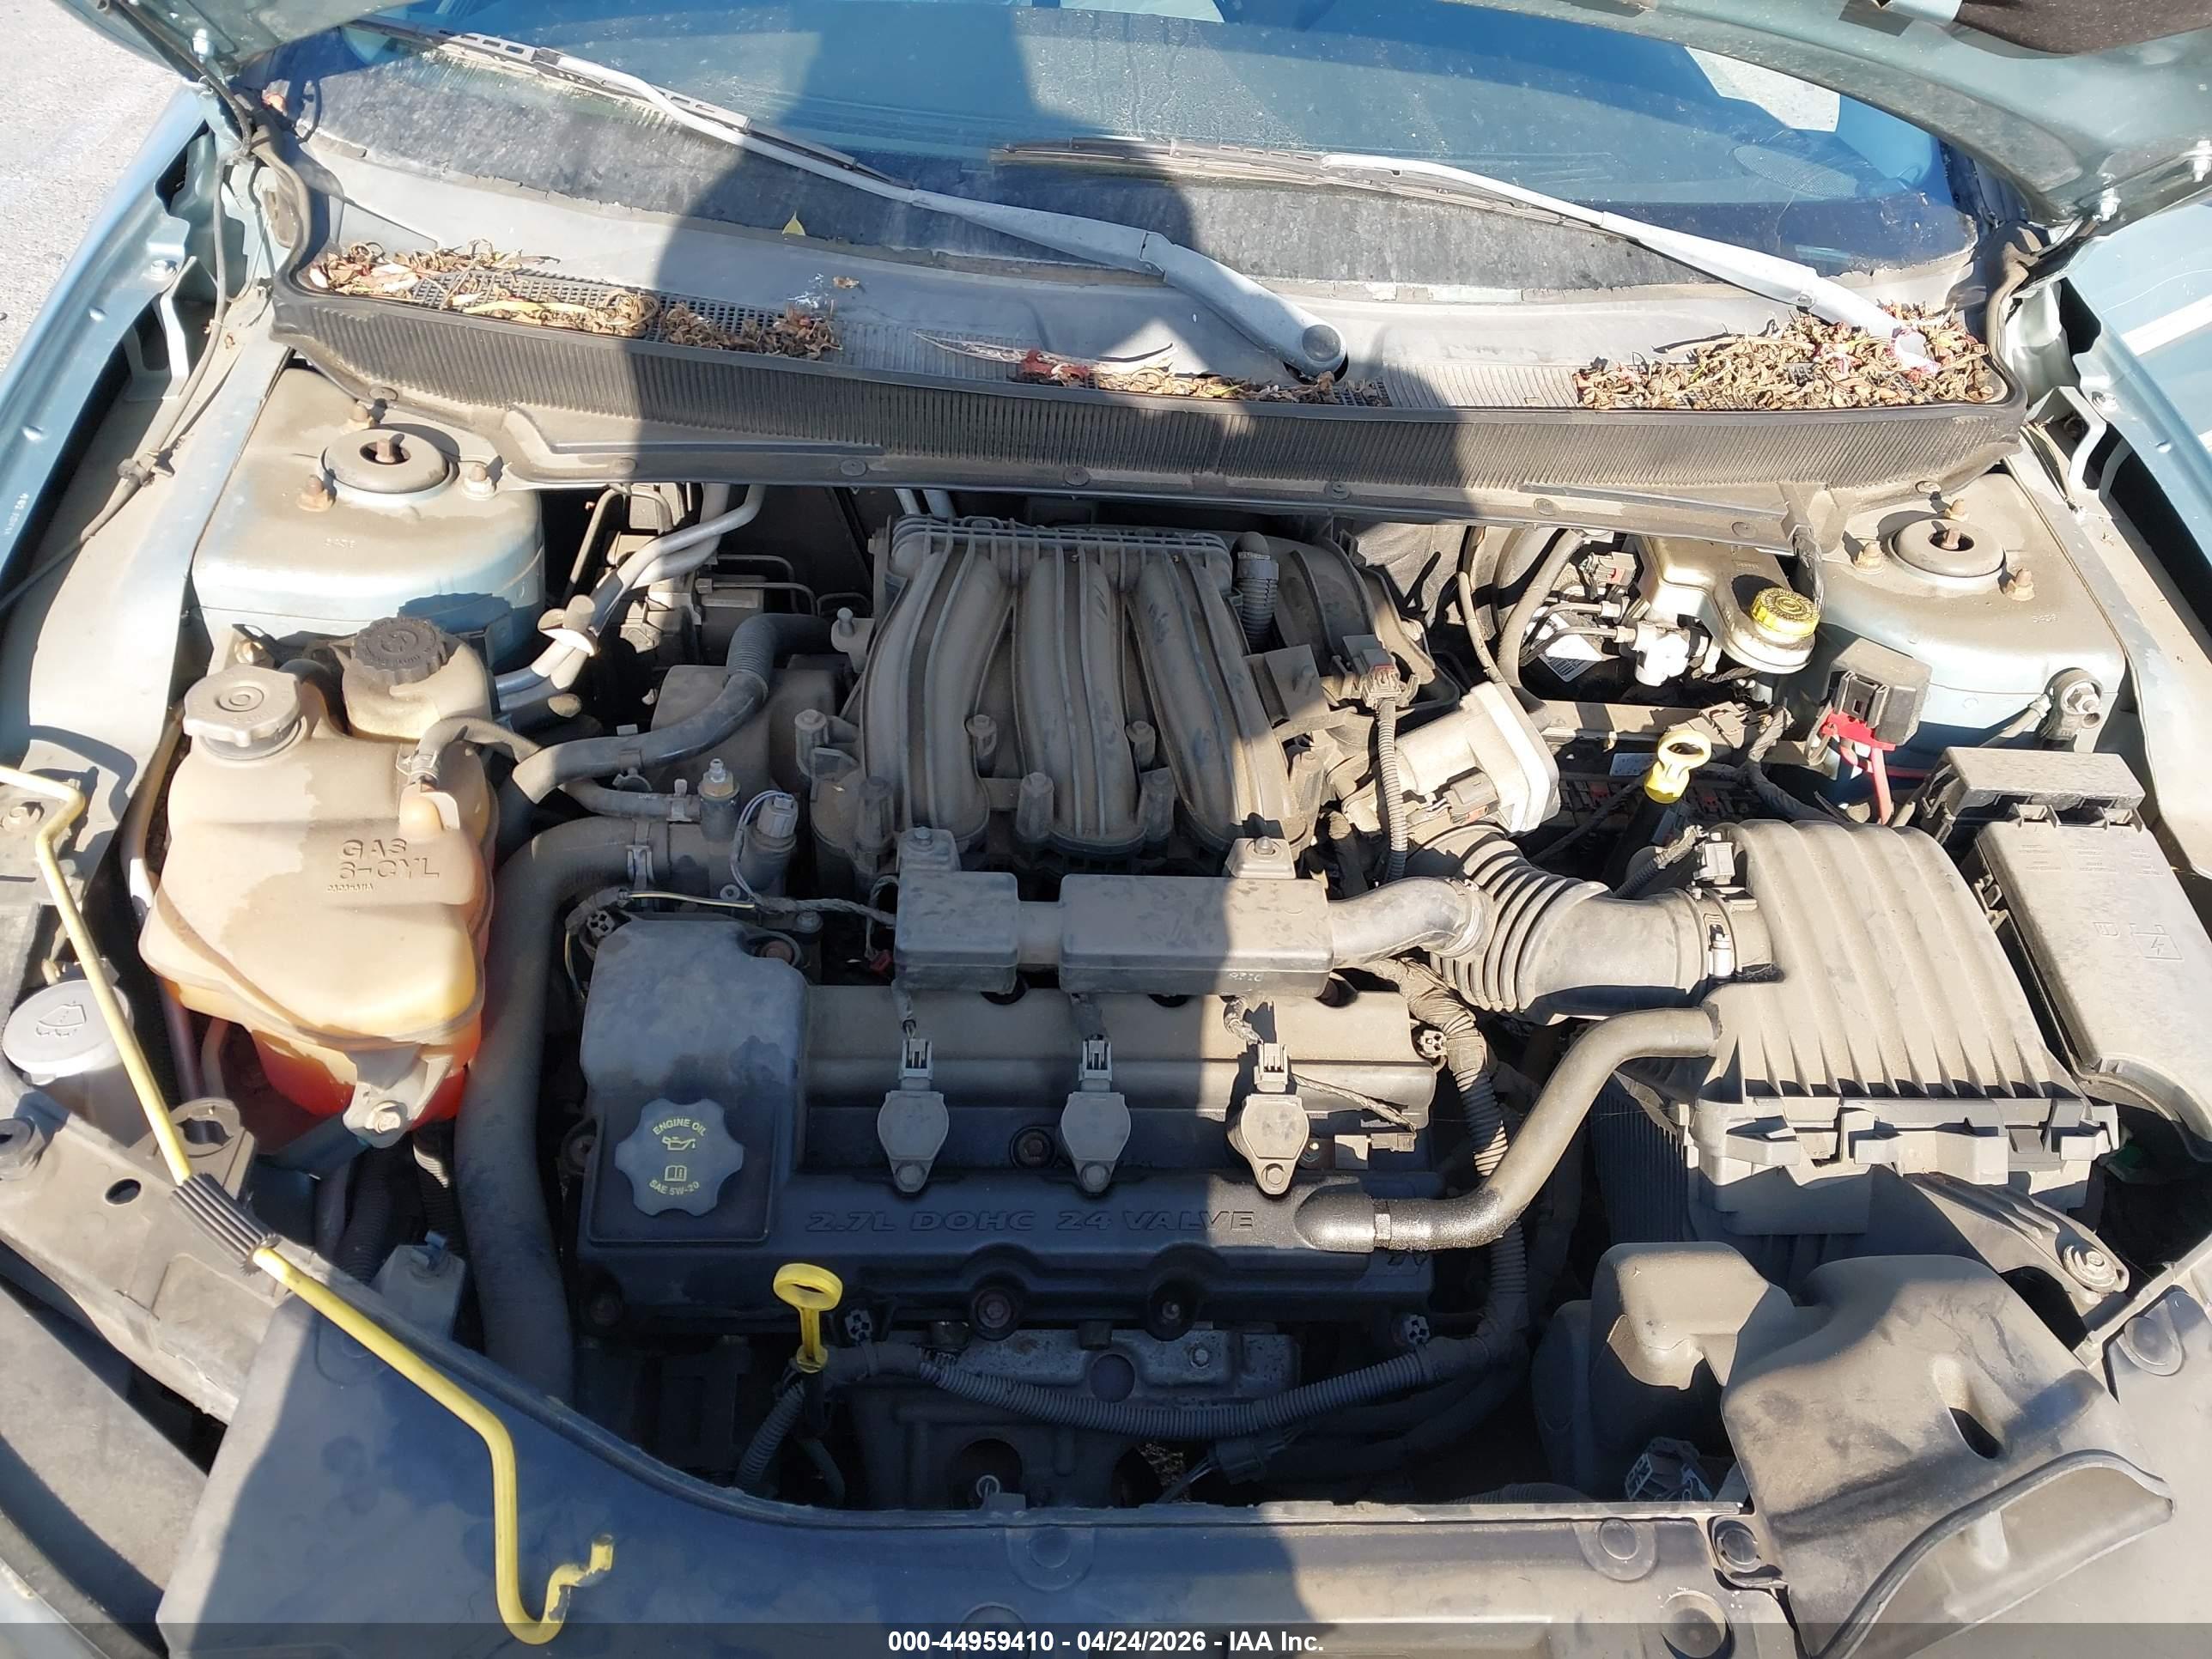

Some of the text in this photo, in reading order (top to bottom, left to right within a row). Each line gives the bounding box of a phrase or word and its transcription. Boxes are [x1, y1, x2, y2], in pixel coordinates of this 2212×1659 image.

[343, 837, 408, 859] GAS
[652, 1118, 708, 1137] ENGINE OIL
[648, 1179, 700, 1195] SAE 5W-20
[805, 1210, 1255, 1232] 2.7L DOHC 24 VALVE
